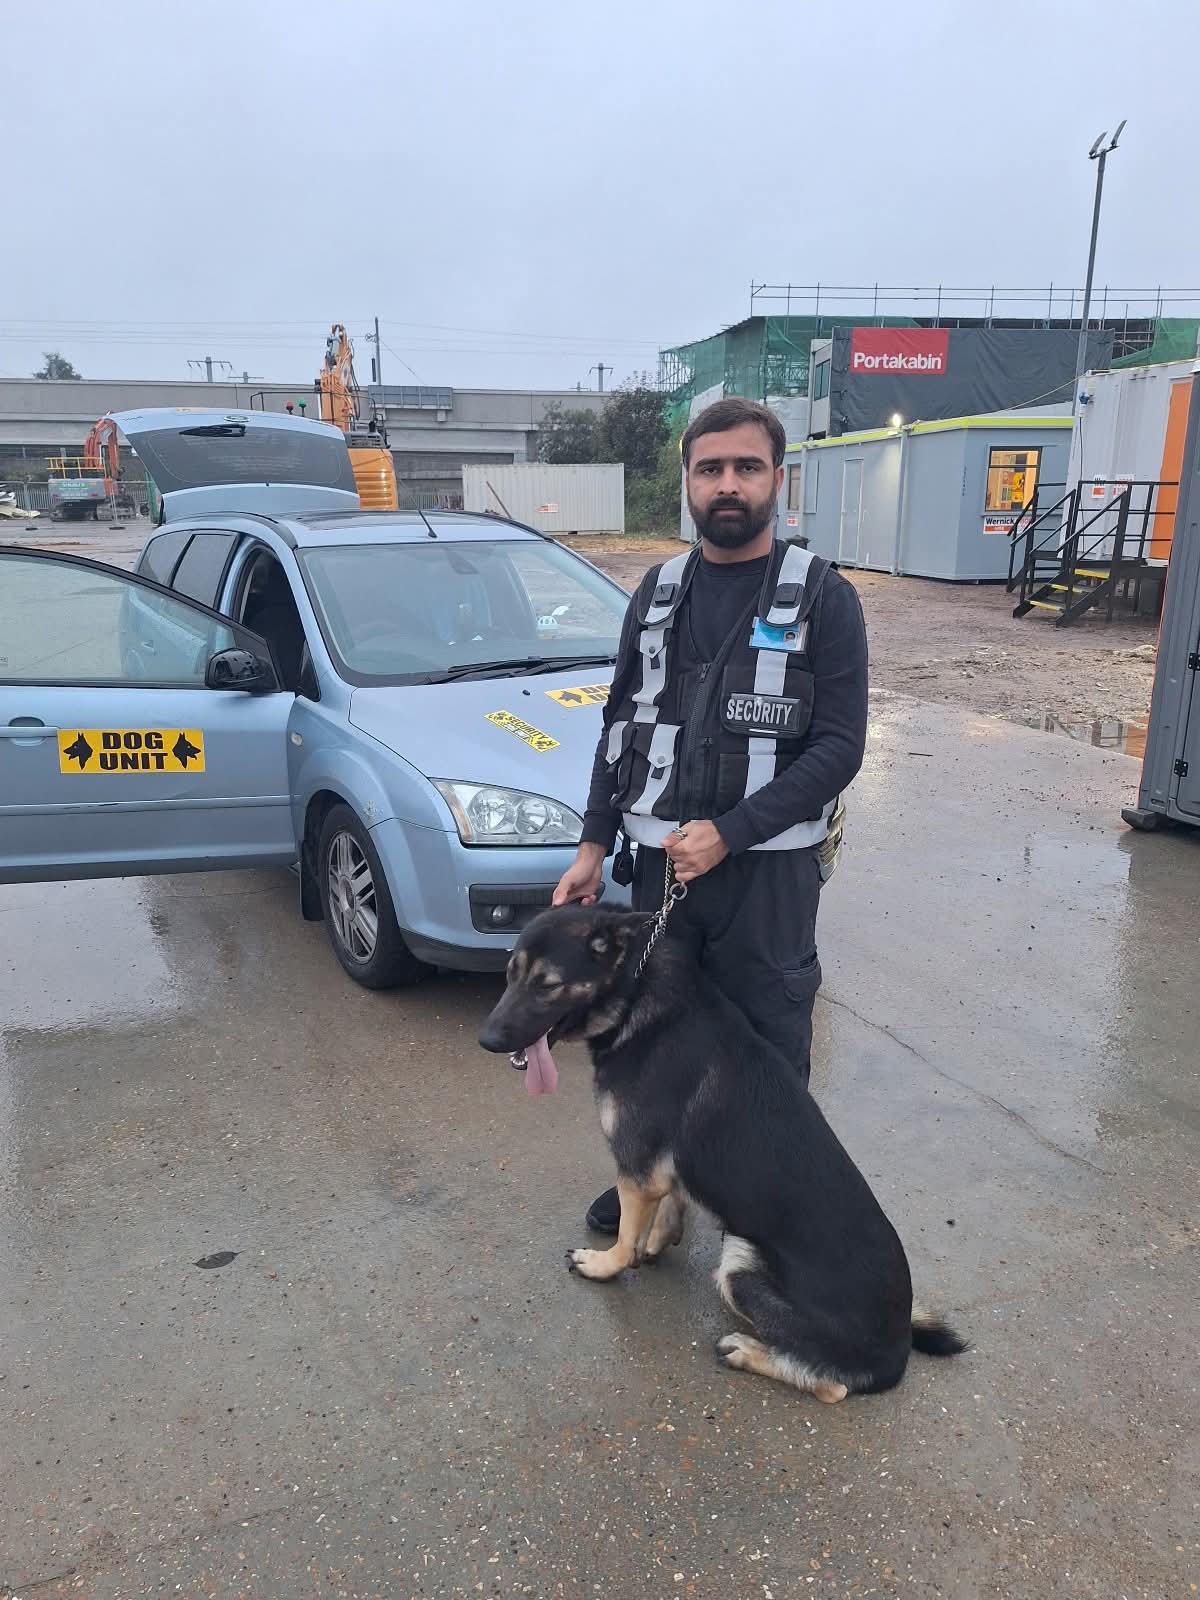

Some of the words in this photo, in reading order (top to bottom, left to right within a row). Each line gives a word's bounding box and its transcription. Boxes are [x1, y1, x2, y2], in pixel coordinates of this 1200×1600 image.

[853, 352, 942, 369] Portakabin
[985, 516, 1015, 525] Wernick
[726, 698, 793, 725] SECURITY
[505, 716, 549, 740] SECURITY
[102, 732, 164, 749] DOG
[99, 752, 168, 770] UNIT
